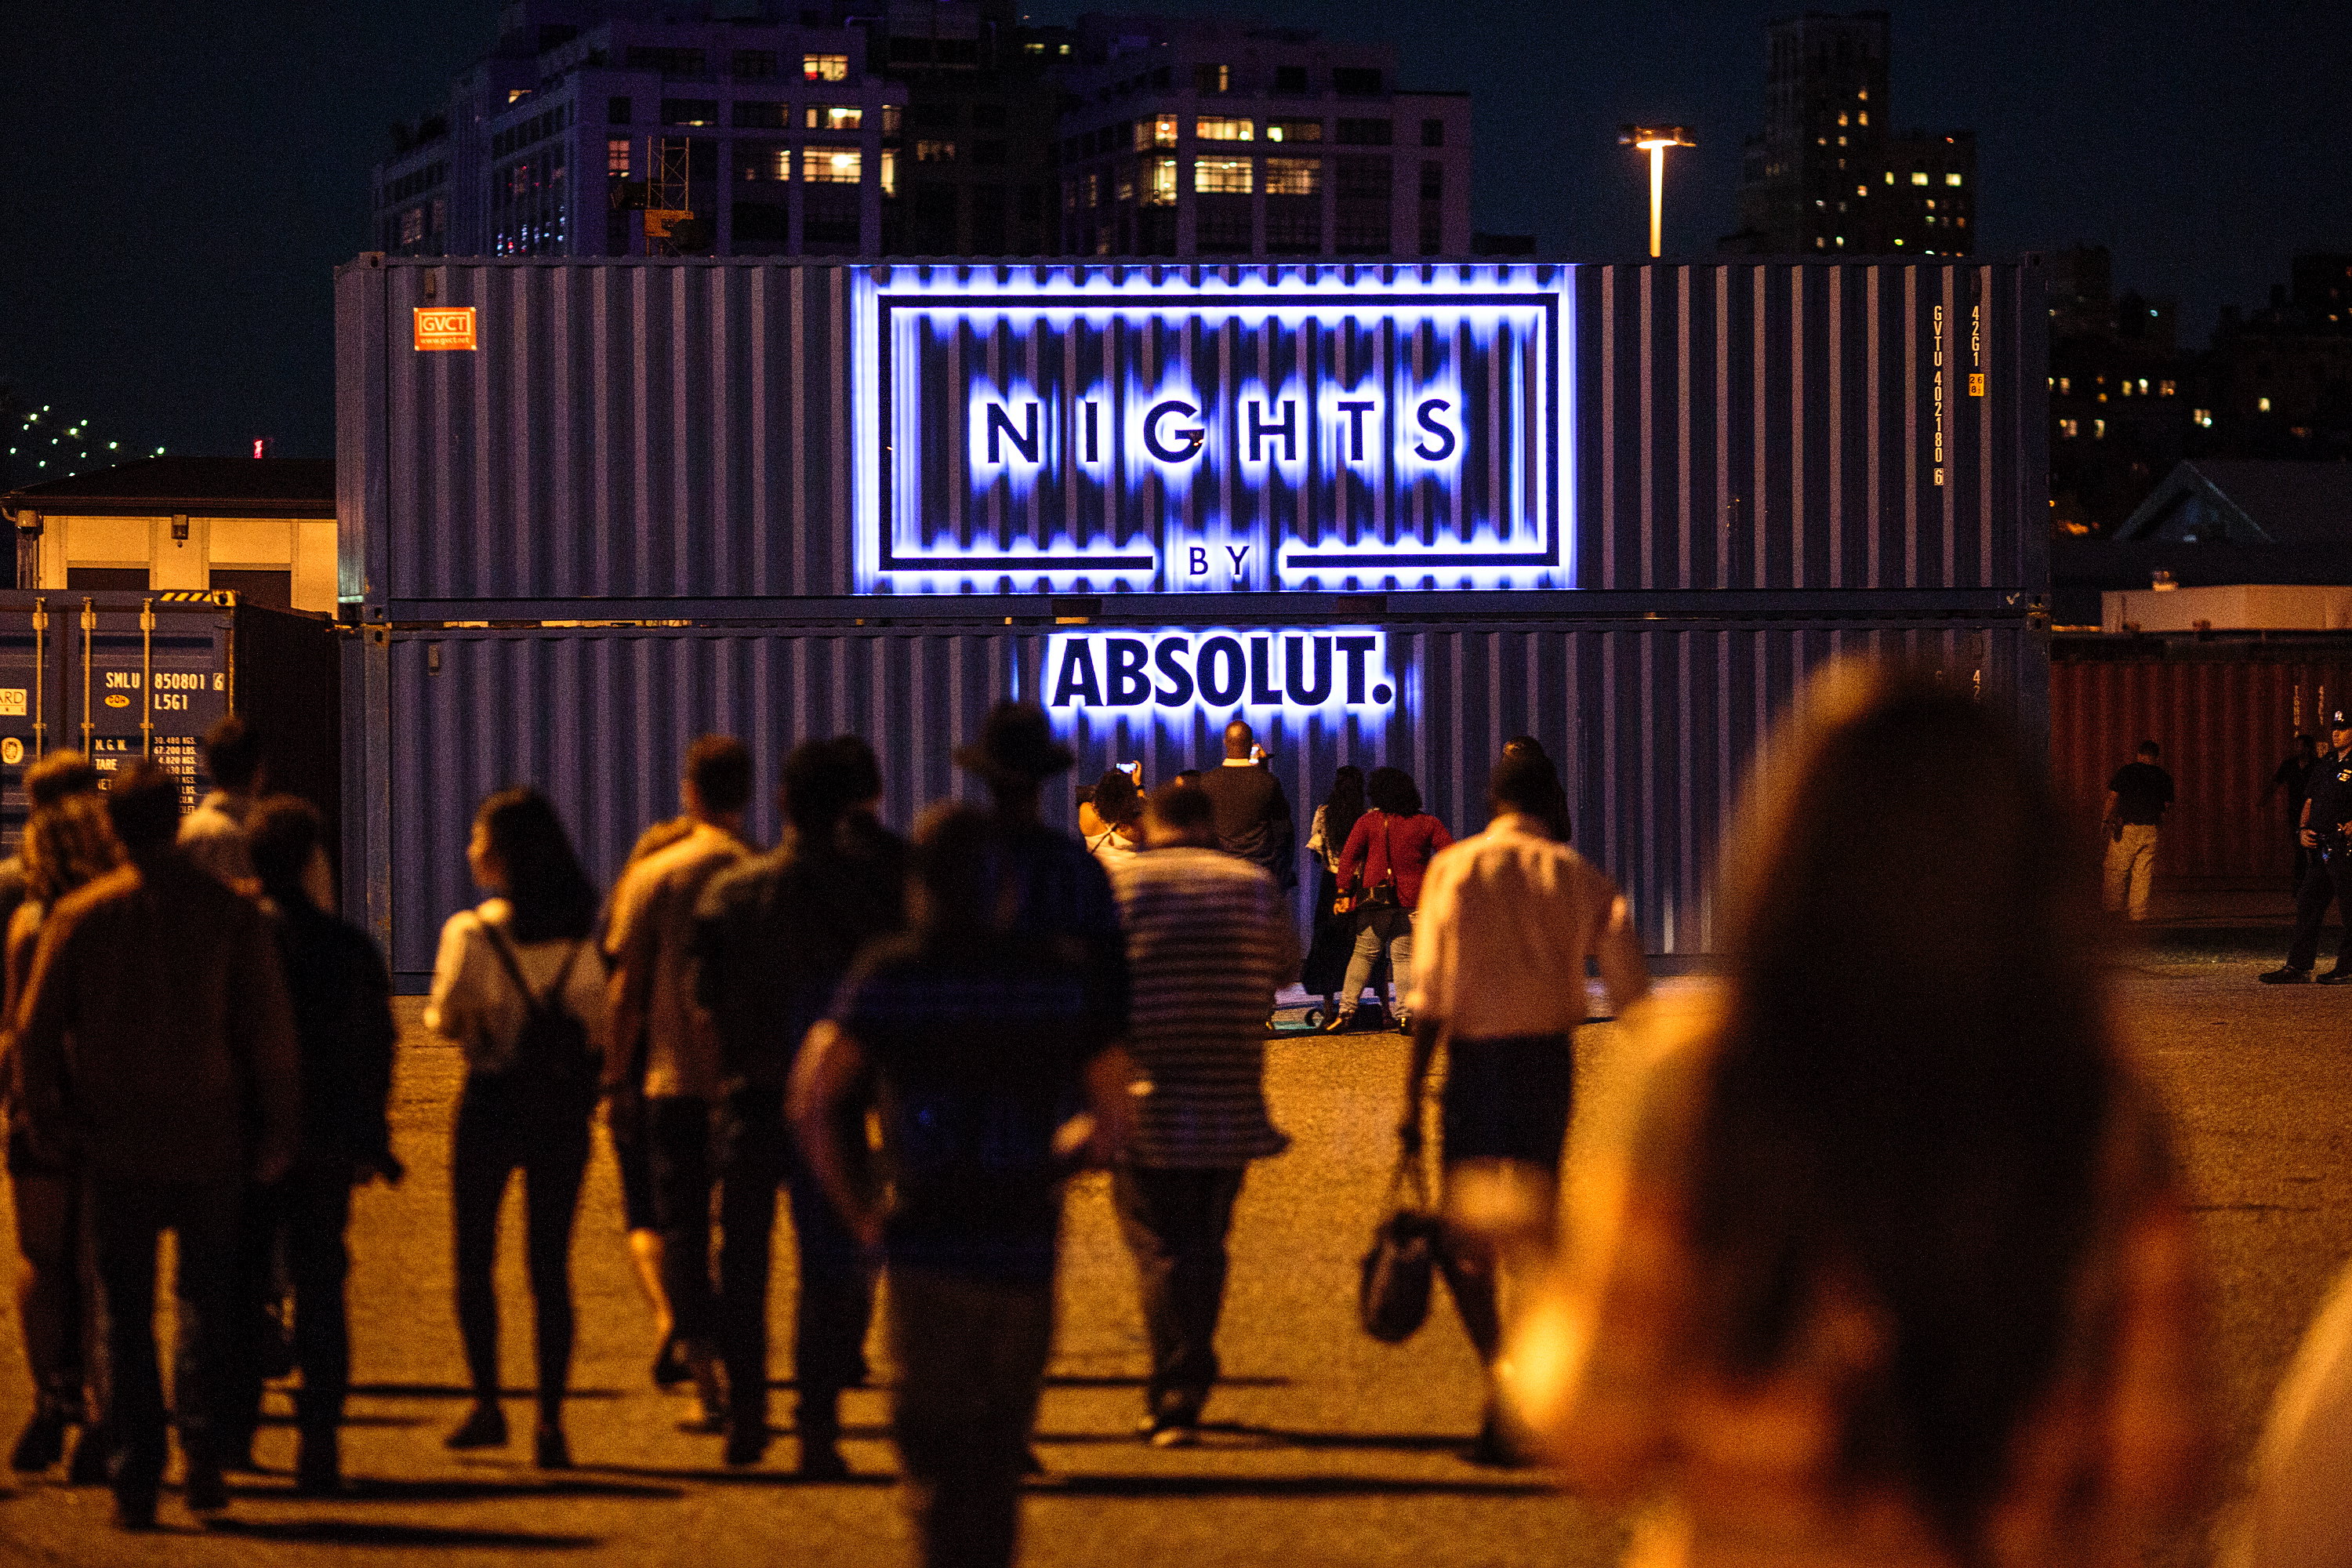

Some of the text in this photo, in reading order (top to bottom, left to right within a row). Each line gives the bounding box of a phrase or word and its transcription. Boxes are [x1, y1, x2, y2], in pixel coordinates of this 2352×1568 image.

[423, 316, 466, 331] GVCT
[1933, 305, 1943, 485] GVTU 402180 6
[986, 397, 1456, 464] NIGHTS
[1189, 546, 1250, 576] BY
[105, 672, 224, 690] SMLU 850801 6
[1050, 636, 1392, 708] ABSOLUT.
[154, 693, 188, 710] L5G1
[95, 758, 118, 771] TARE
